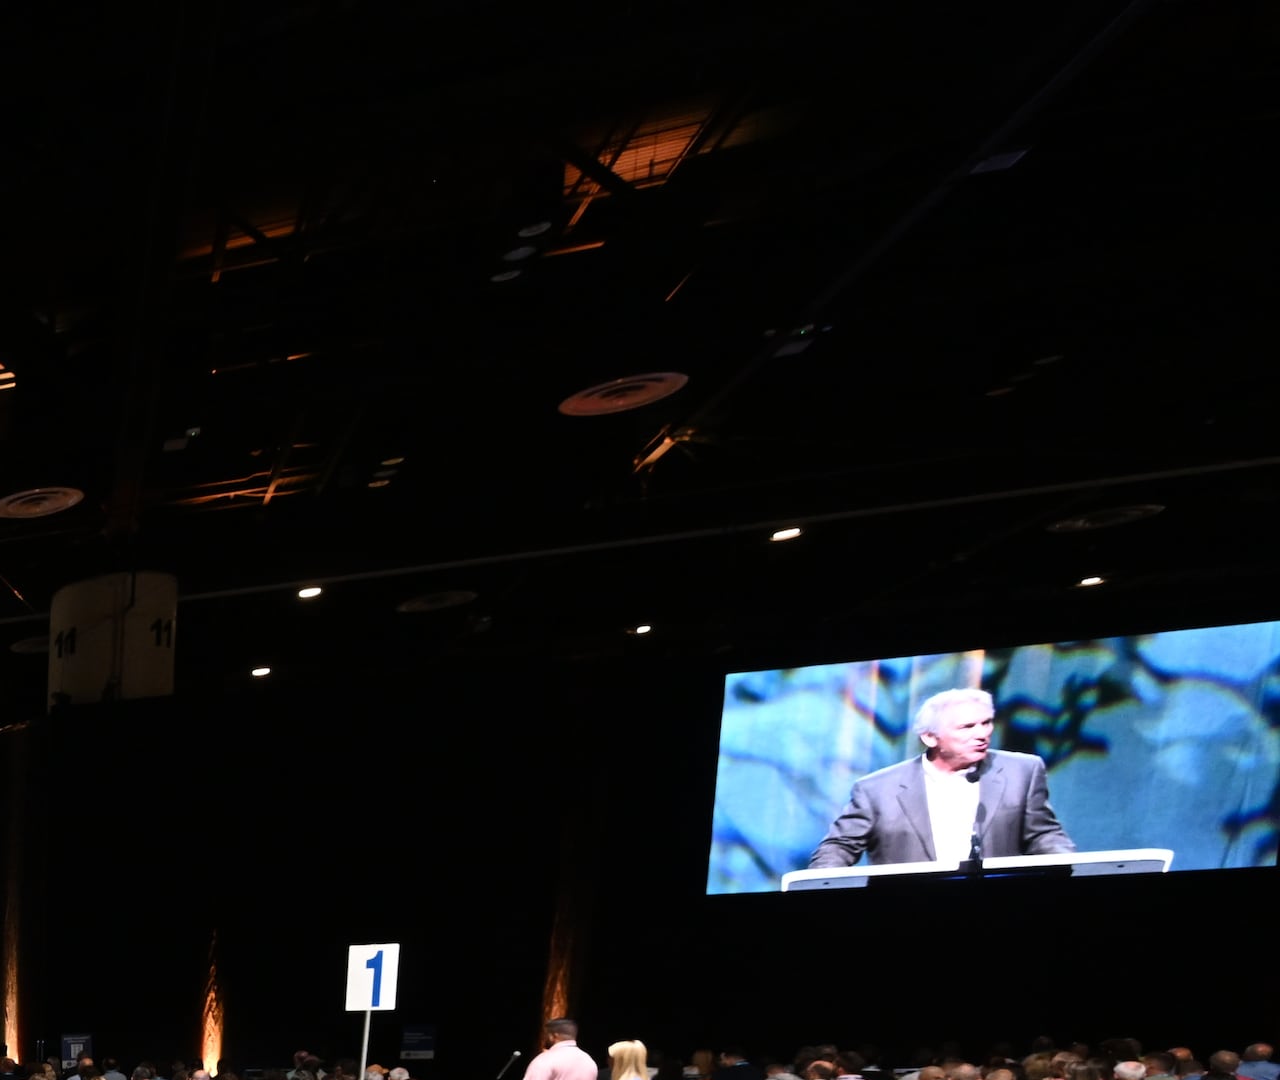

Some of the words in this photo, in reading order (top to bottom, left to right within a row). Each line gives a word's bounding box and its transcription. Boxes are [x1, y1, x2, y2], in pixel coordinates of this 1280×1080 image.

[54, 627, 77, 658] 11
[150, 617, 173, 648] 11
[366, 950, 384, 1007] 1
